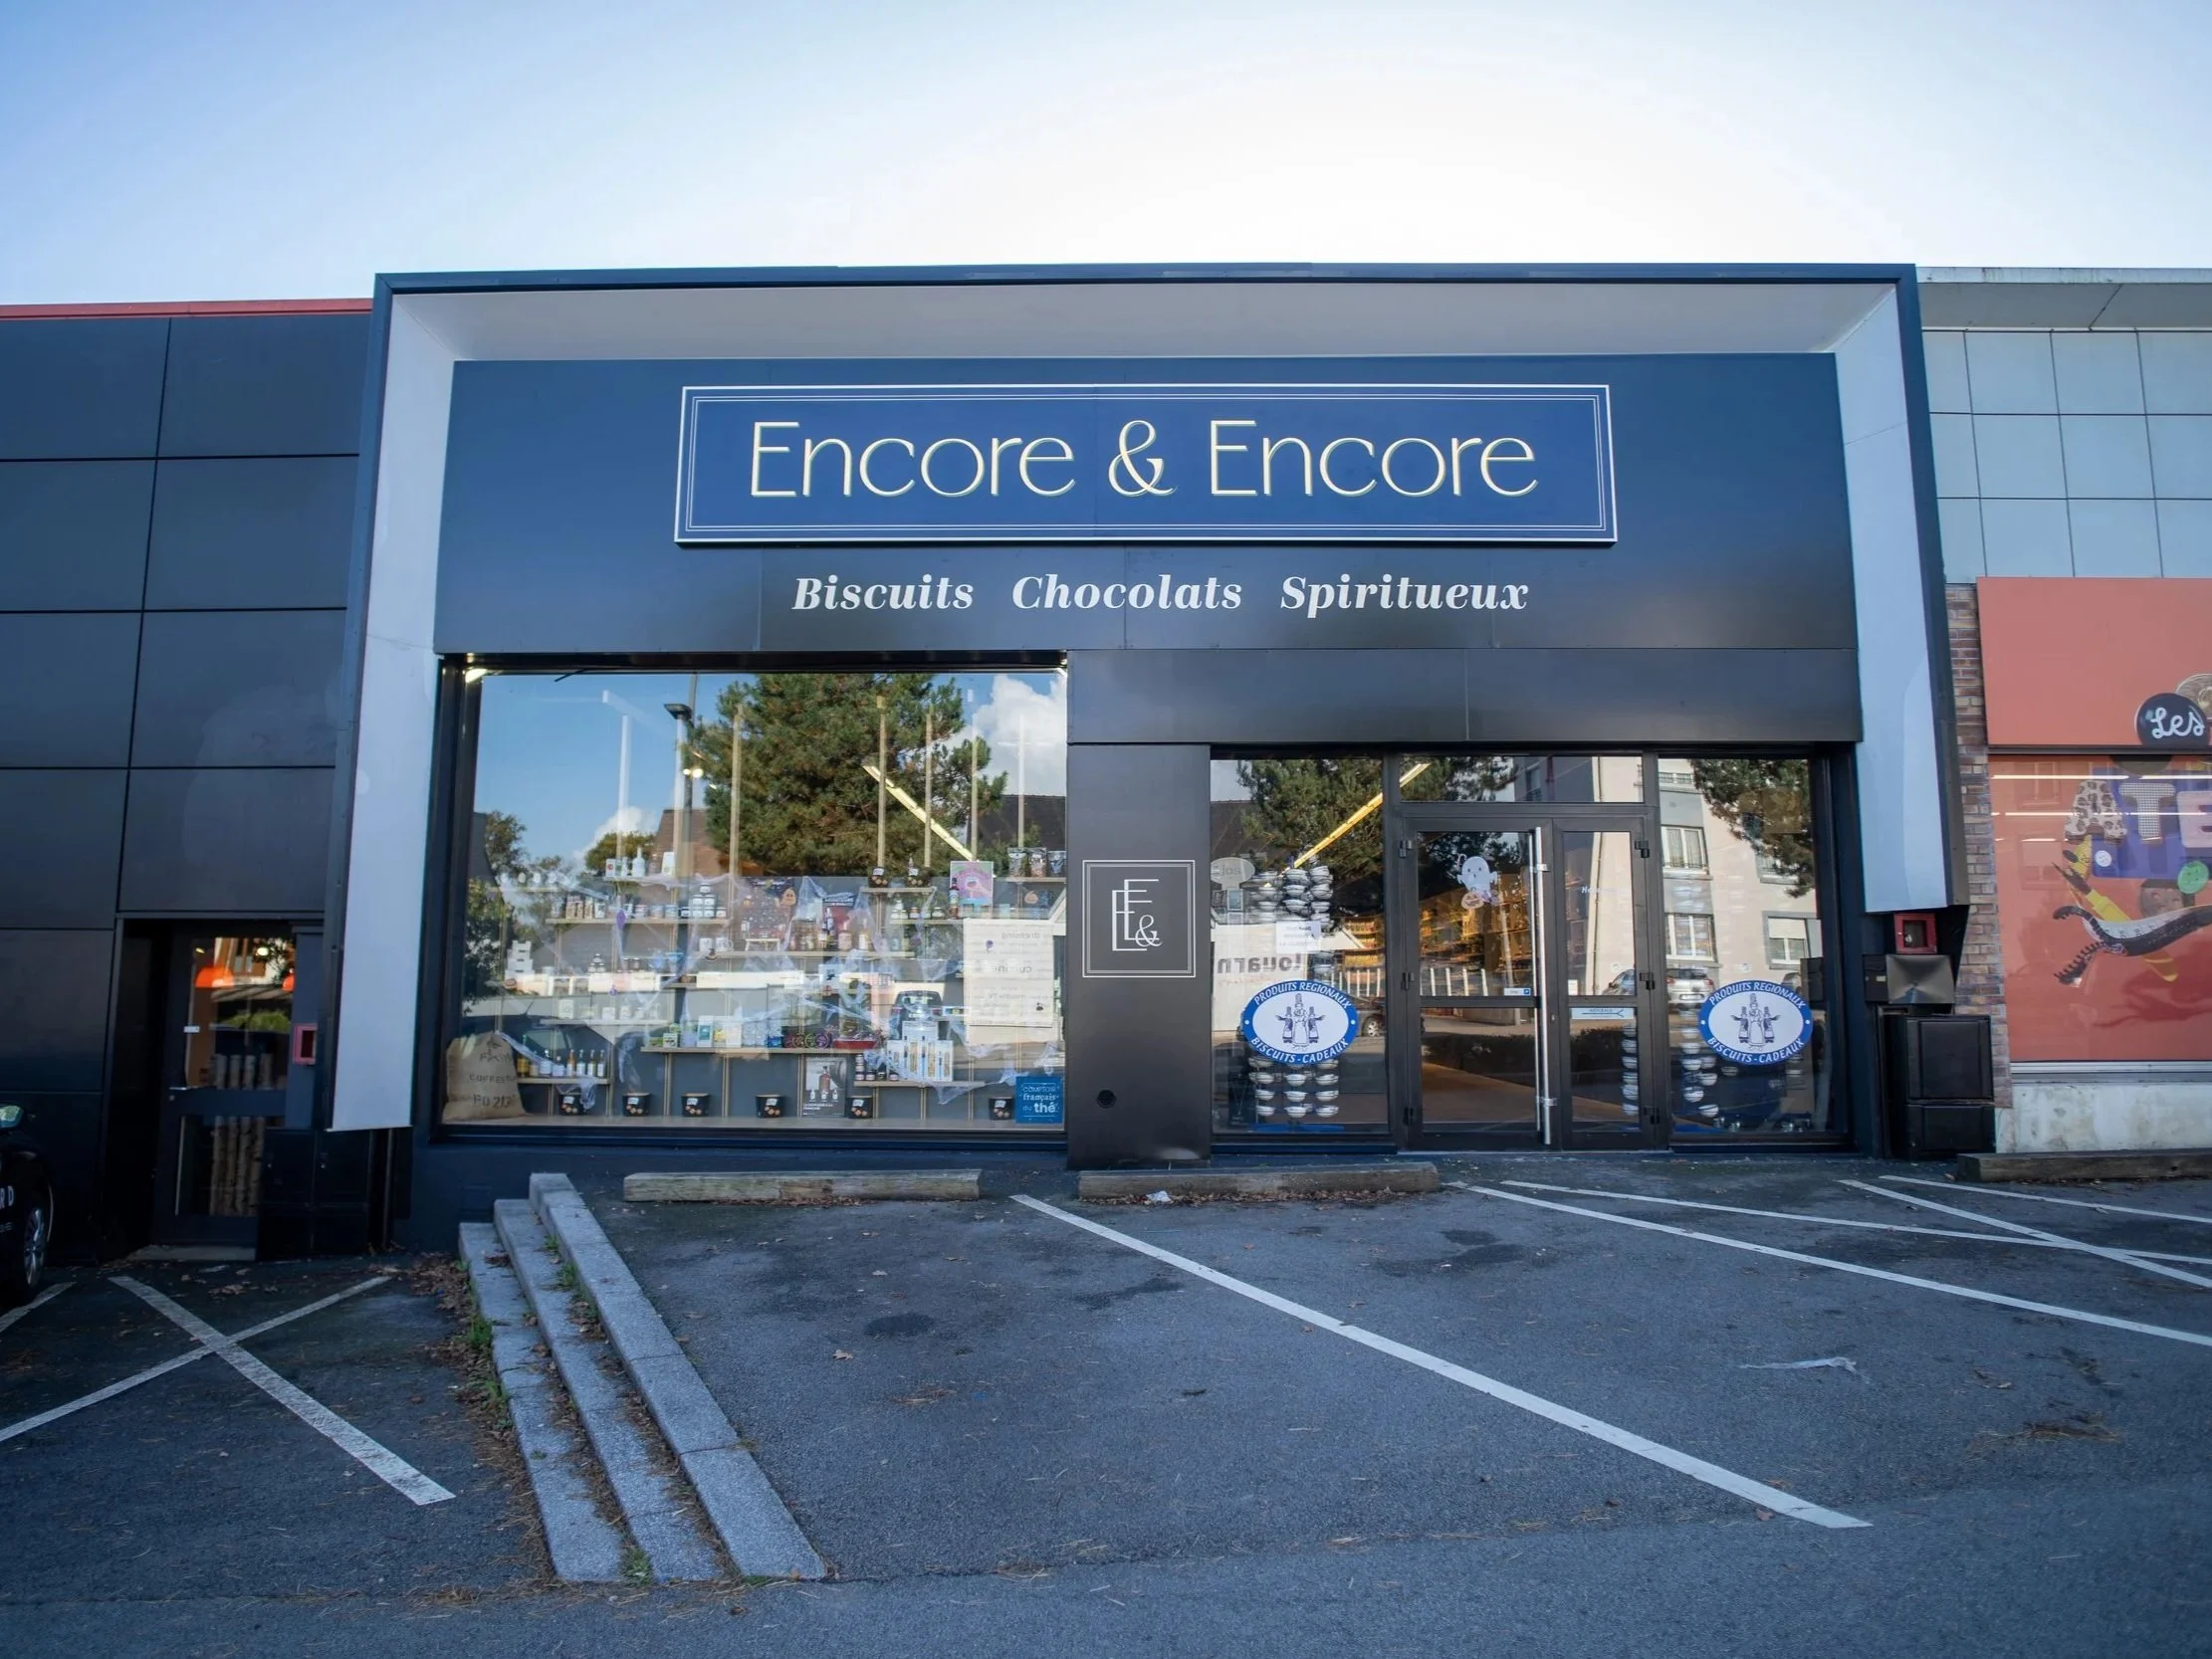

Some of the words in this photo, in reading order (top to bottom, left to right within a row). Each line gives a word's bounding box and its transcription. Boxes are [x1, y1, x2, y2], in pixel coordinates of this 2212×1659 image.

[751, 421, 1076, 497] Encore
[1108, 419, 1178, 497] &
[1210, 419, 1539, 497] Encore
[791, 574, 975, 609] Biscuits
[1011, 574, 1243, 609] Chocolats
[1280, 573, 1529, 618] Spiritueux
[2150, 707, 2206, 739] Les
[1253, 981, 1297, 1006] PRODUITS
[1298, 981, 1353, 1009] REGIONAUX
[1708, 981, 1752, 1006] PRODUITS
[1753, 981, 1807, 1009] REGIONAUX
[1250, 1036, 1296, 1064] BISCUITS
[1302, 1038, 1350, 1064] CADEAUX
[1707, 1036, 1753, 1063] BISCUITS
[1758, 1038, 1805, 1063] CADEAUX
[1033, 1101, 1056, 1114] thé
